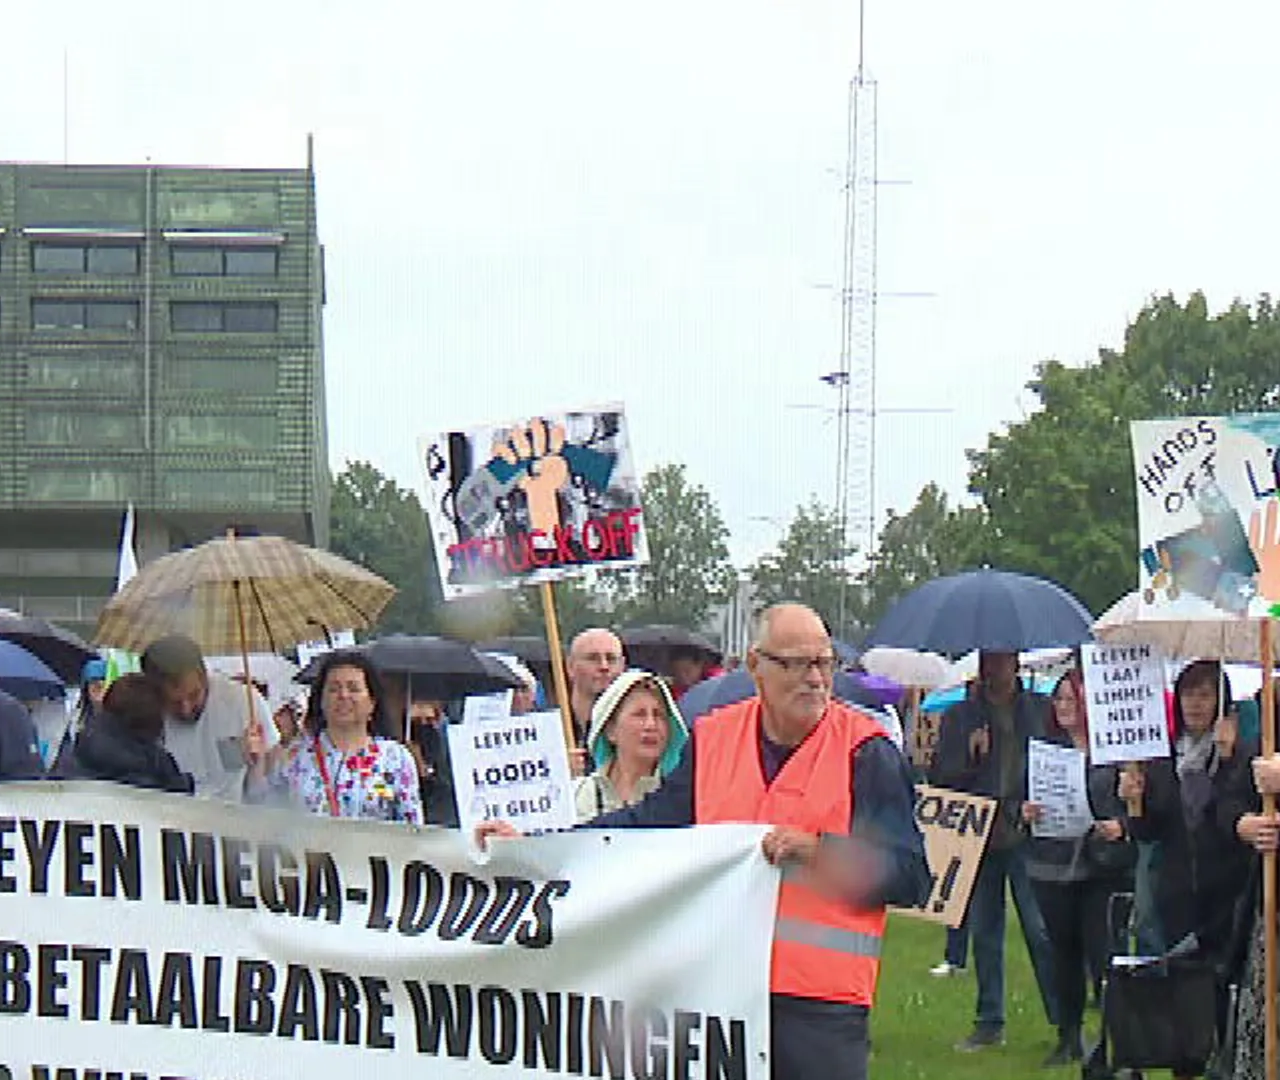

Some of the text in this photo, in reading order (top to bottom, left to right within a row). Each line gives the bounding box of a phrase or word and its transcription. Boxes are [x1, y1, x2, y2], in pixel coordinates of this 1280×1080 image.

[1139, 420, 1218, 497] HANDS
[447, 506, 644, 576] TRUCK OFF
[473, 727, 538, 750] LEEYEN
[472, 759, 551, 786] LOODS
[506, 796, 552, 815] GELD
[160, 827, 571, 949] MEGA-LOODS
